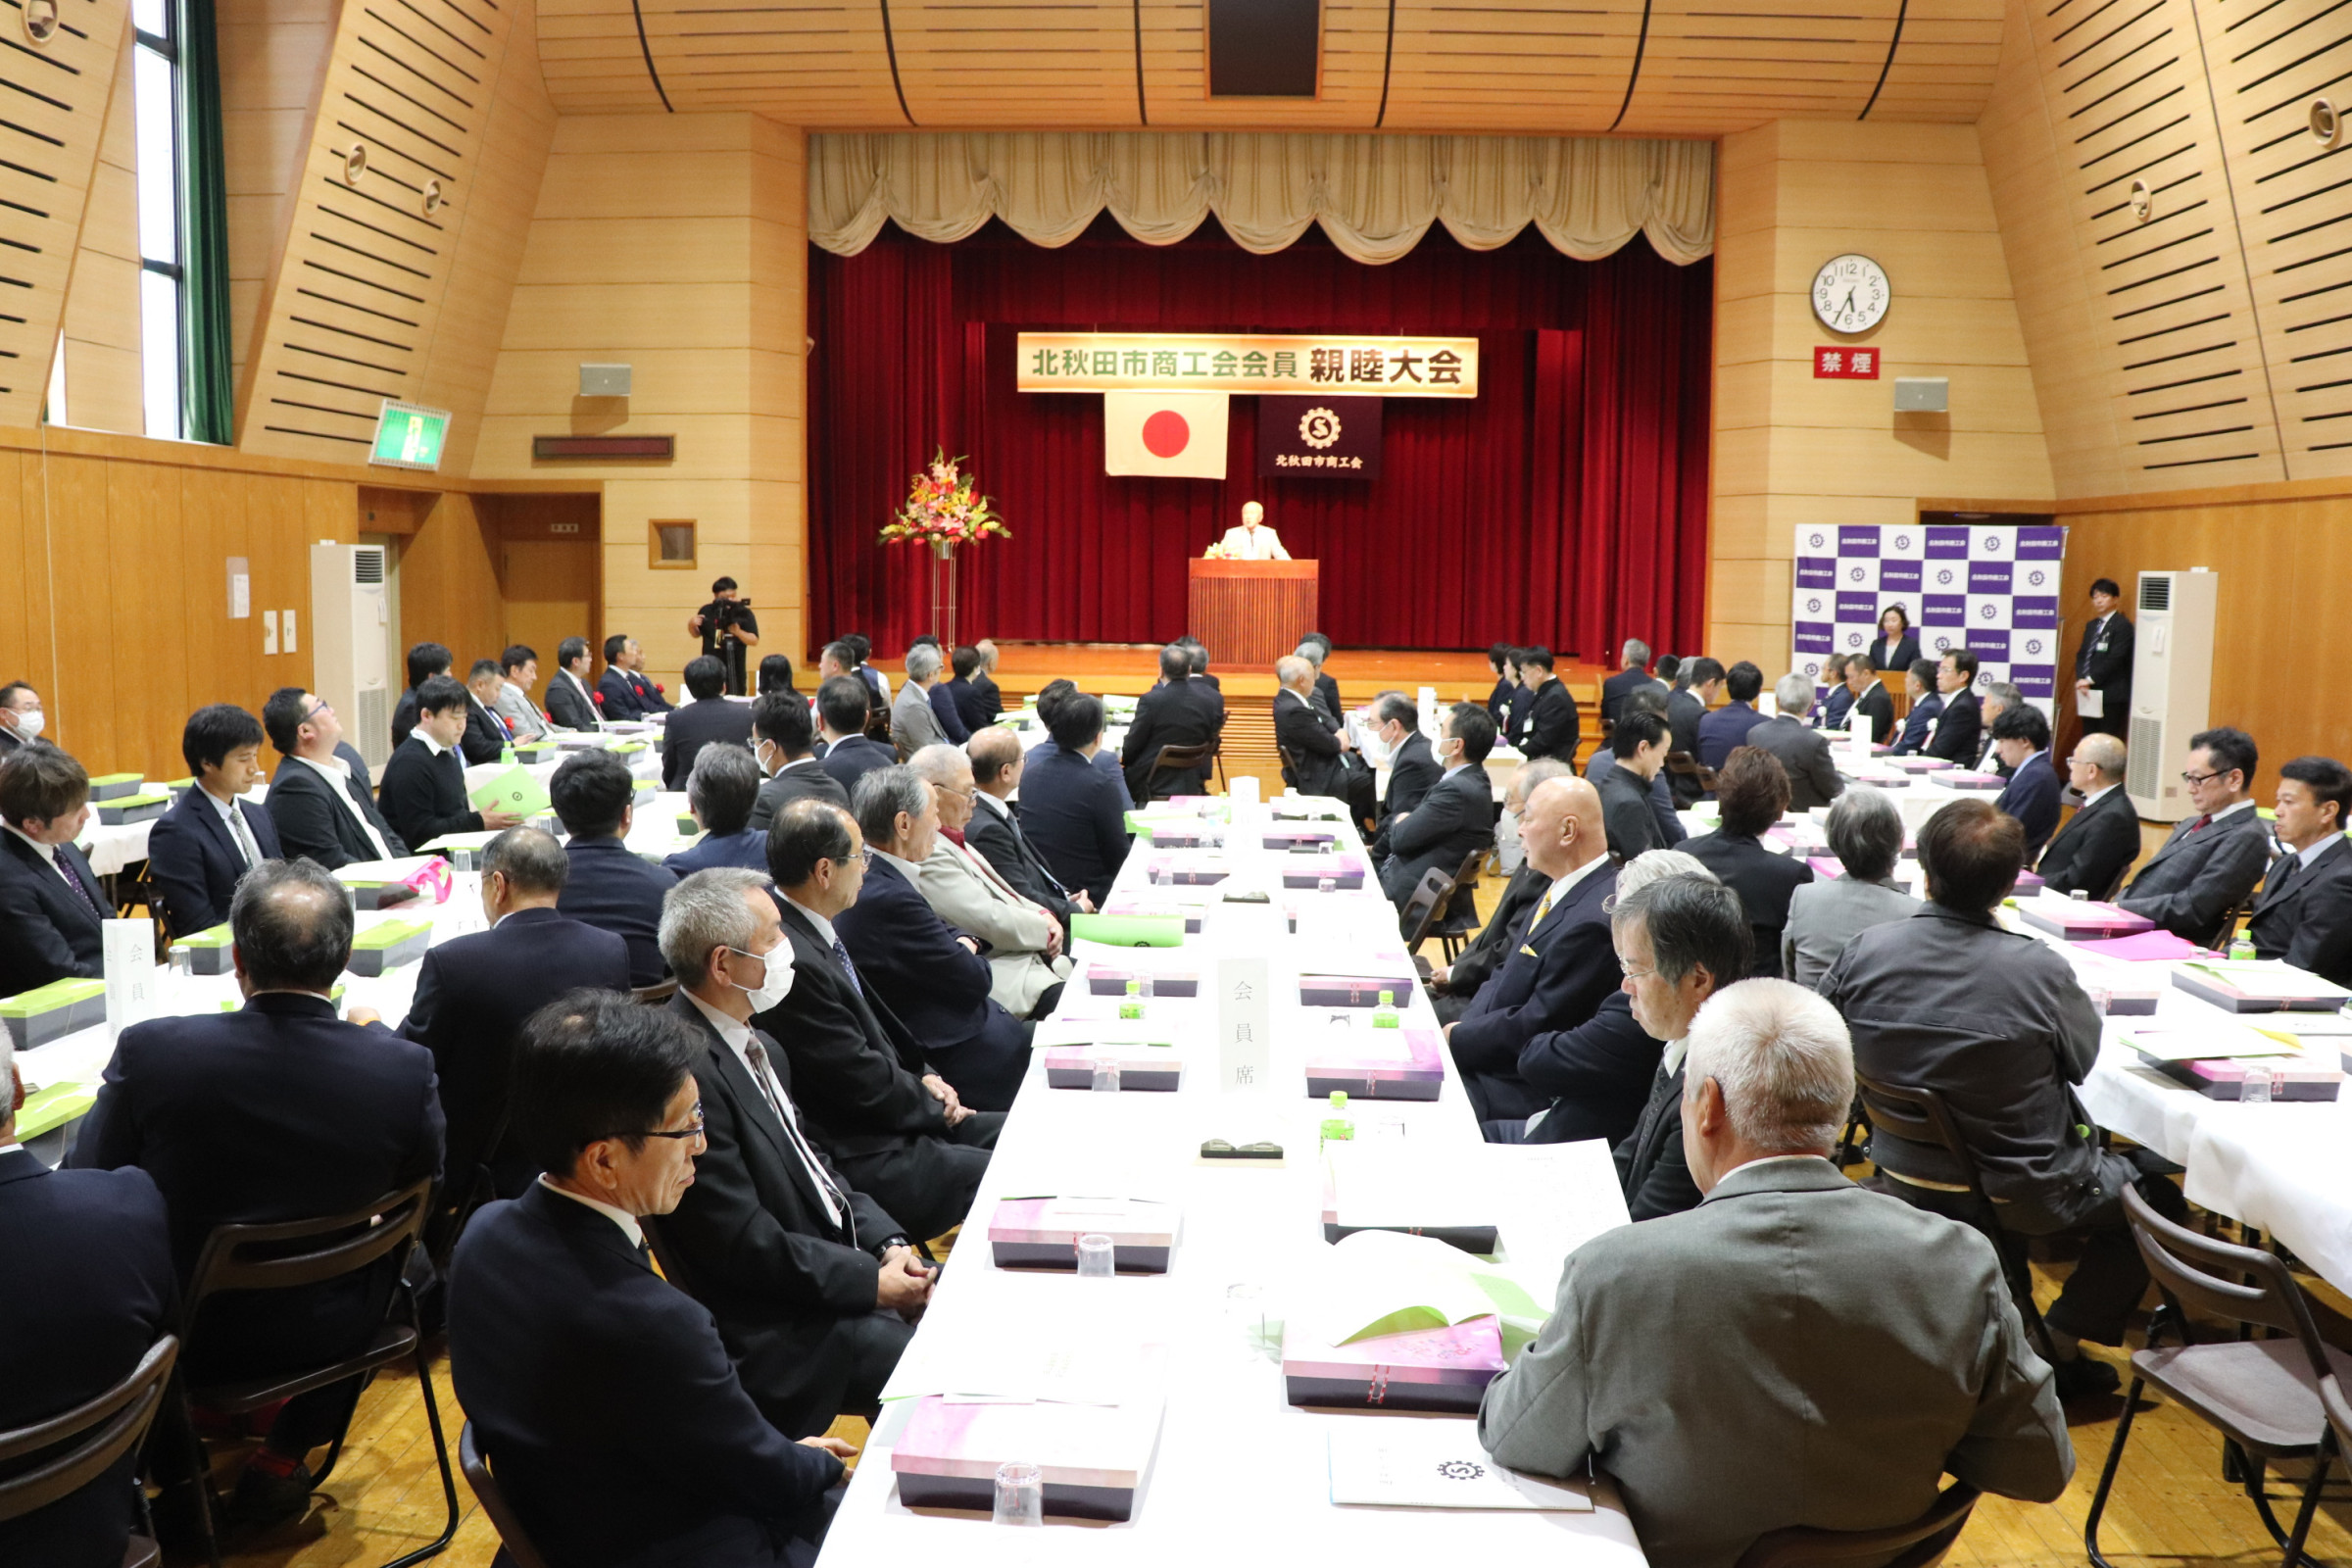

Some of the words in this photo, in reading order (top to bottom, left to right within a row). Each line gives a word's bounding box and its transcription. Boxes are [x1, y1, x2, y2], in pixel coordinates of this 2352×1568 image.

[1845, 263, 1858, 274] 12
[1869, 275, 1878, 287] 2
[1819, 288, 1828, 299] 9
[1872, 289, 1881, 300] 3
[1824, 300, 1832, 312] 8
[1867, 302, 1875, 313] 4
[1844, 314, 1853, 325] 6
[1858, 311, 1866, 322] 5
[1032, 348, 1298, 378] 北秋田市商工会会員
[1309, 347, 1463, 384] 親睦大会
[1822, 352, 1872, 373] 禁煙
[1275, 454, 1363, 469] 北秋田市商工会
[1233, 980, 1254, 1085] 会員席
